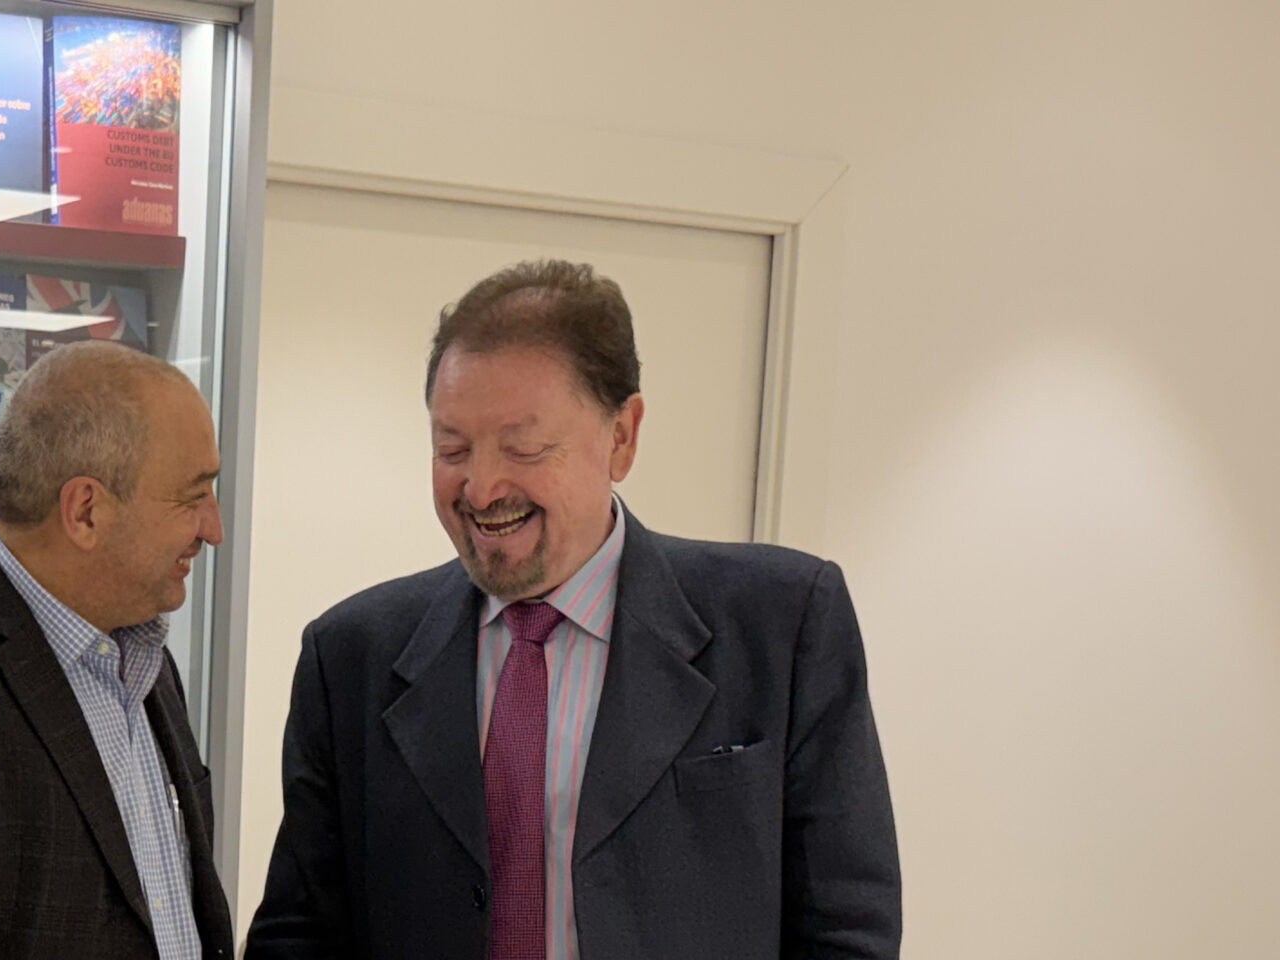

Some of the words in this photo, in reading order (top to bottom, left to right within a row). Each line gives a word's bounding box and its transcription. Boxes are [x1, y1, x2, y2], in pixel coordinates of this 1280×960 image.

[107, 129, 150, 144] CUSTOMS
[109, 143, 141, 156] UNDER
[143, 148, 160, 159] THE
[105, 156, 148, 170] CUSTOMS
[150, 161, 173, 174] CODE
[122, 196, 173, 225] aduanas
